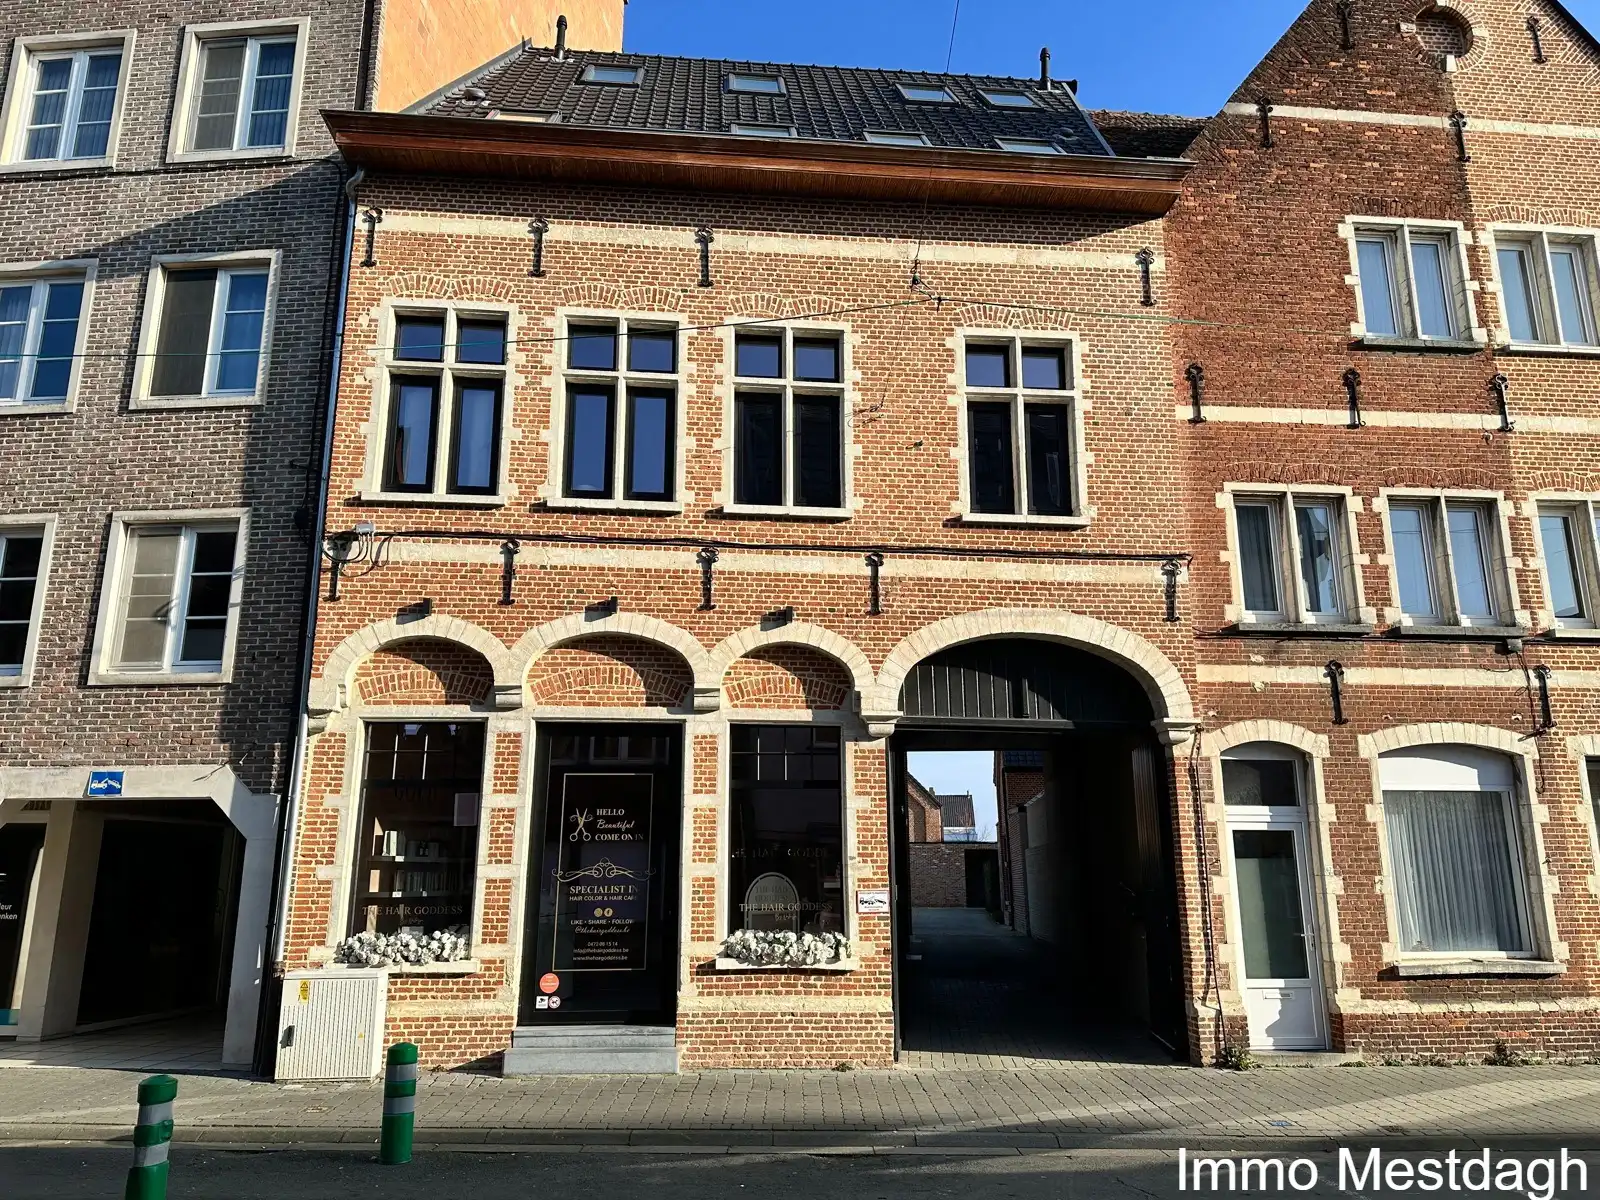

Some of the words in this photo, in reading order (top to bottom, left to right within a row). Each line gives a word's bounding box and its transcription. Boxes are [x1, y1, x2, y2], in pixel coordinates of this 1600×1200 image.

[596, 808, 625, 816] HELLO
[596, 819, 635, 831] Beautiful
[595, 833, 620, 841] COME
[621, 833, 633, 841] ON
[569, 885, 627, 894] SPECIALIST
[628, 884, 638, 893] IN
[414, 905, 463, 915] GODDESS
[738, 903, 758, 912] THE
[761, 903, 785, 912] HAIR
[787, 902, 833, 912] GODDESS
[0, 912, 17, 920] nken
